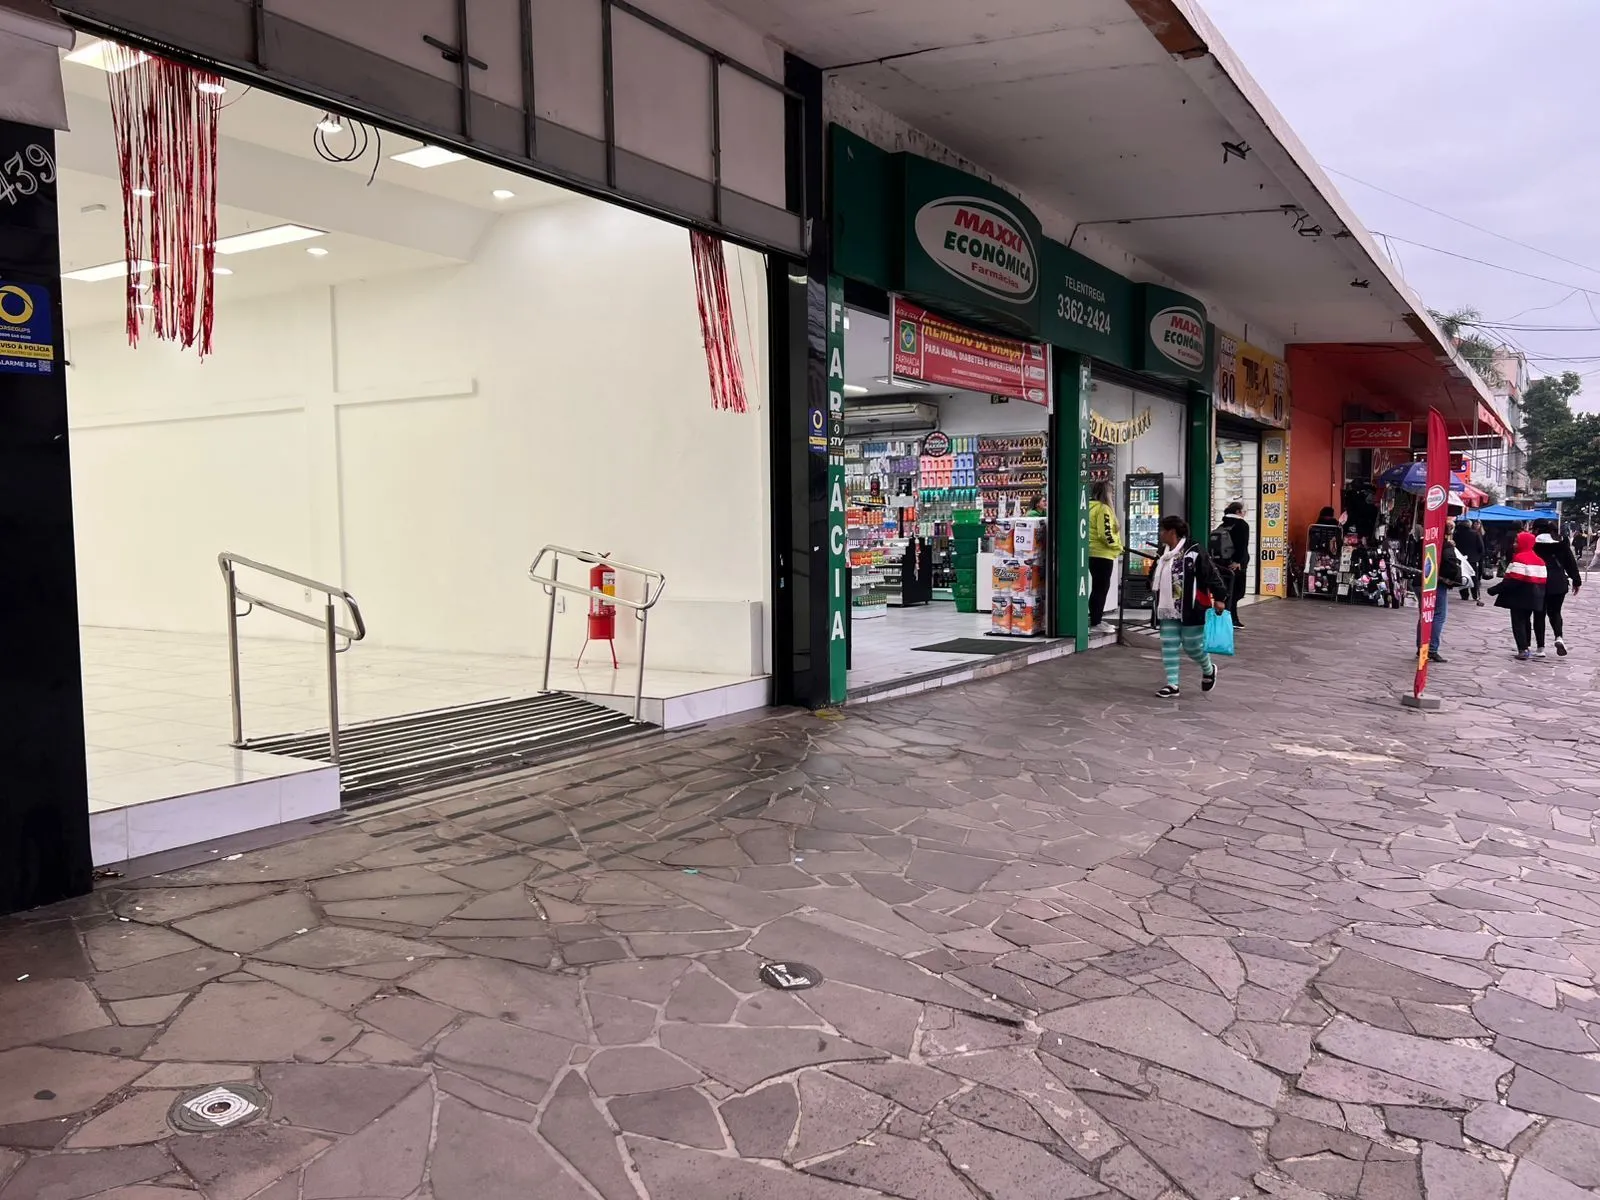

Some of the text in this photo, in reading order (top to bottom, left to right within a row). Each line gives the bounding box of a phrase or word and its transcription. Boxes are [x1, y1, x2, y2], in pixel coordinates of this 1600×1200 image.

[954, 208, 1023, 253] MAXXI
[944, 230, 1031, 284] ECONÔMICA
[971, 262, 1019, 289] Farmácias
[1065, 275, 1106, 303] TELENTREGA
[1057, 293, 1111, 336] 3362-2424
[0, 342, 17, 350] VISO
[925, 343, 940, 356] PARA
[959, 351, 984, 367] DIABETES
[984, 357, 989, 367] E
[895, 364, 920, 377] POPULAR
[1222, 371, 1236, 404] 80
[1273, 393, 1283, 421] 80
[830, 436, 844, 446] STV
[1079, 372, 1088, 598] FARÁCIA
[1262, 483, 1276, 494] 80
[1015, 535, 1025, 544] 29
[1261, 549, 1275, 561] 80
